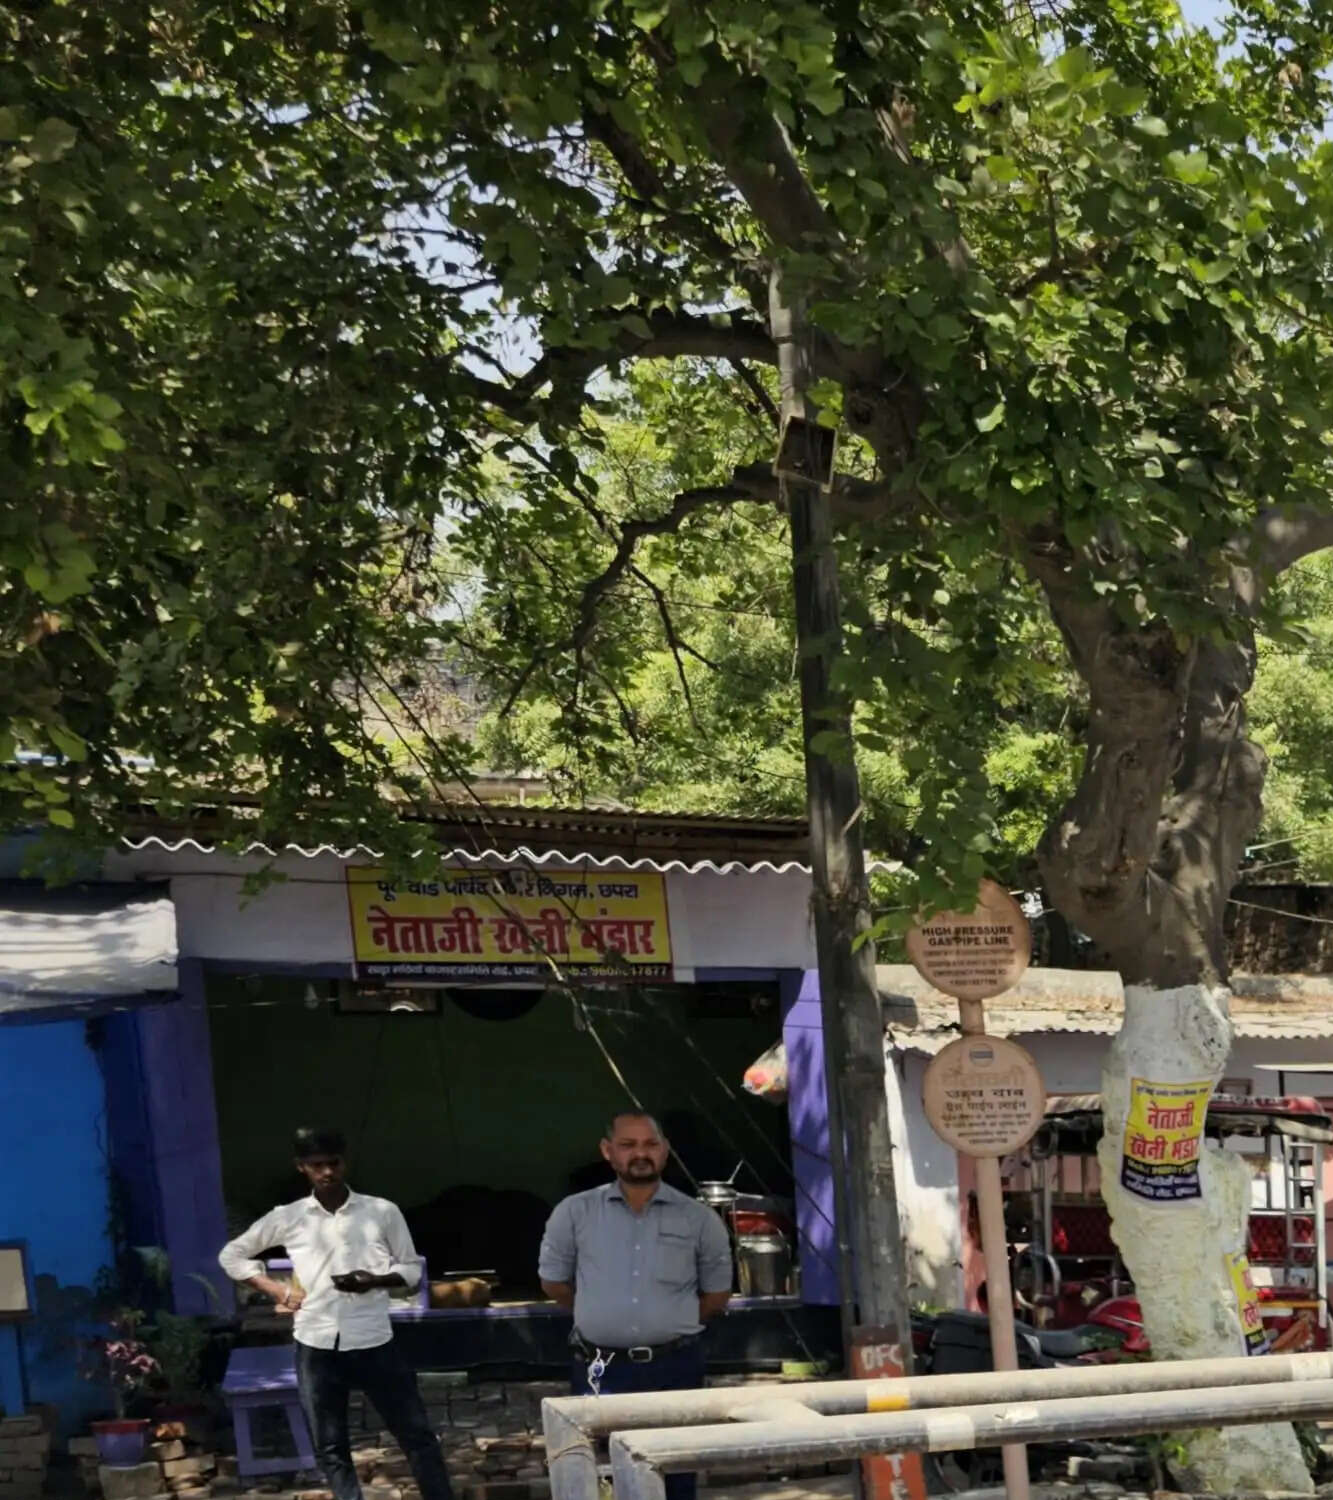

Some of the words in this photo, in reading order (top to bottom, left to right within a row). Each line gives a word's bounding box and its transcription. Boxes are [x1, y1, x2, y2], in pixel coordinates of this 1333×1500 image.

[367, 904, 484, 954] नेताजी
[922, 926, 951, 936] HIGH
[953, 925, 1015, 936] PRESSURE
[984, 936, 1009, 946] LINE
[1147, 1100, 1194, 1129] नेताजी
[1130, 1132, 1168, 1161] खैनी
